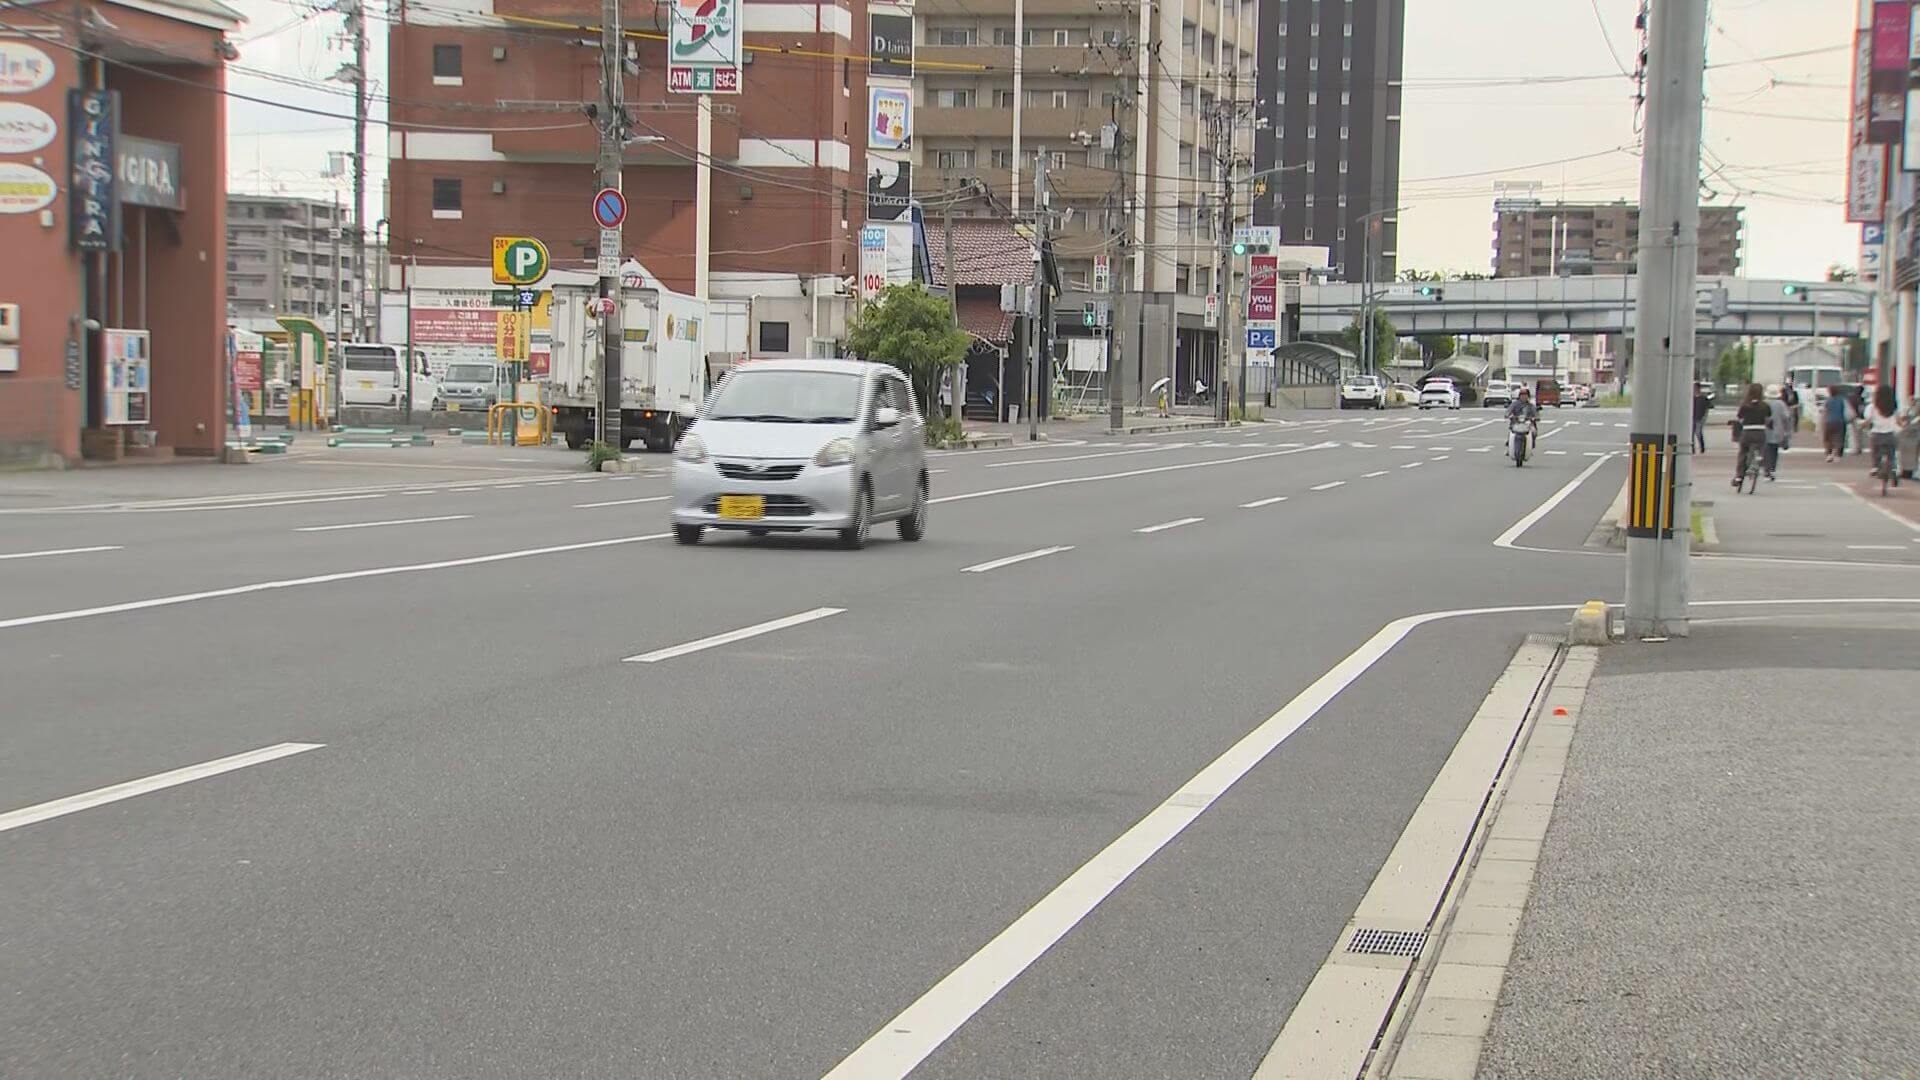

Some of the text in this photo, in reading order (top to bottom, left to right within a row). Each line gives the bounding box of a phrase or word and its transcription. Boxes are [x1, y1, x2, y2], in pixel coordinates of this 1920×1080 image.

[672, 71, 691, 88] ATM
[697, 71, 711, 88] 酒
[717, 71, 736, 88] たばこ
[1864, 226, 1879, 241] P
[516, 247, 538, 276] P
[521, 292, 534, 305] 空
[1252, 295, 1272, 306] you
[1256, 304, 1273, 312] me
[1250, 332, 1261, 346] P
